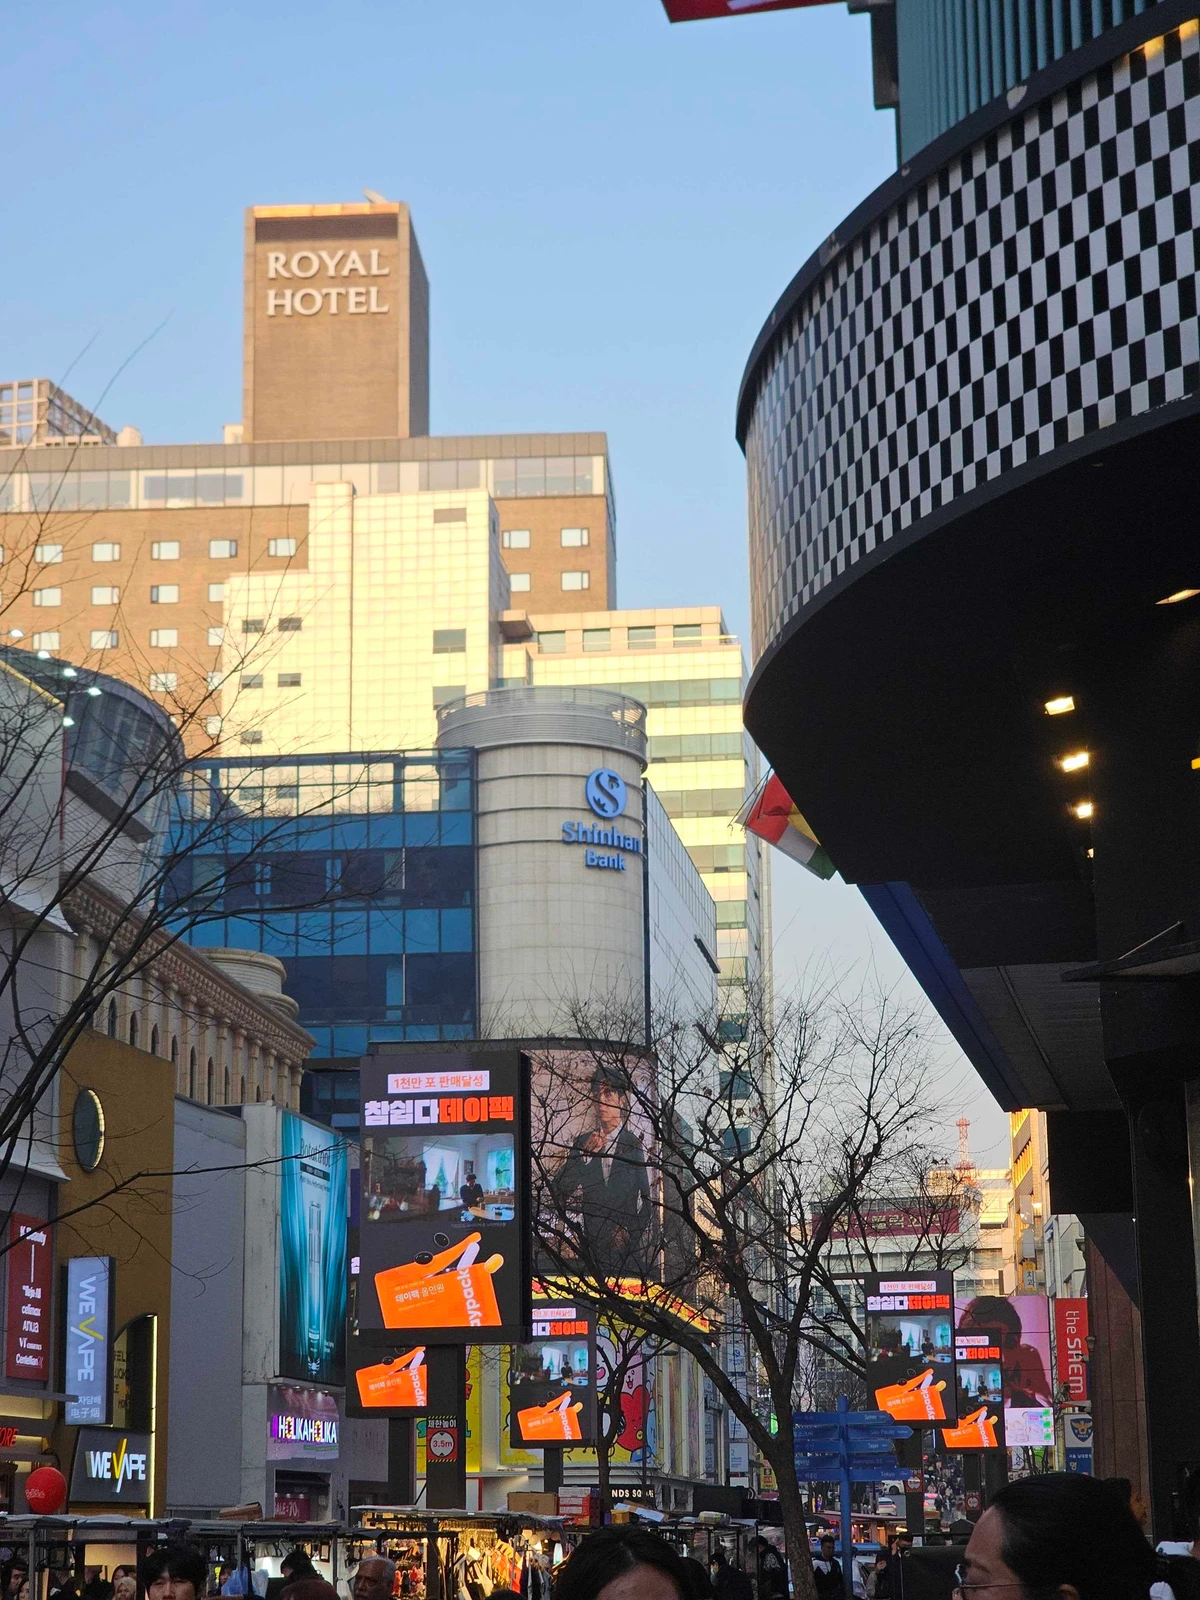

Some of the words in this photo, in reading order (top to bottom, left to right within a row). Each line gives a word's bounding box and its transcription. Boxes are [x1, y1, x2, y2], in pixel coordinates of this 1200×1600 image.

[267, 249, 390, 279] ROYAL
[266, 286, 390, 316] HOTEL
[562, 820, 642, 854] Shinhan
[585, 849, 627, 872] Bank
[393, 1076, 422, 1090] 1천만
[425, 1076, 436, 1088] 포
[438, 1074, 484, 1089] 판매달성
[71, 1276, 104, 1382] WEVAPE
[1065, 1310, 1080, 1335] the
[70, 1407, 101, 1419] 电子烟
[0, 1427, 18, 1448] ORE
[432, 1440, 453, 1448] 3.5m
[87, 1438, 147, 1493] WEVAPE
